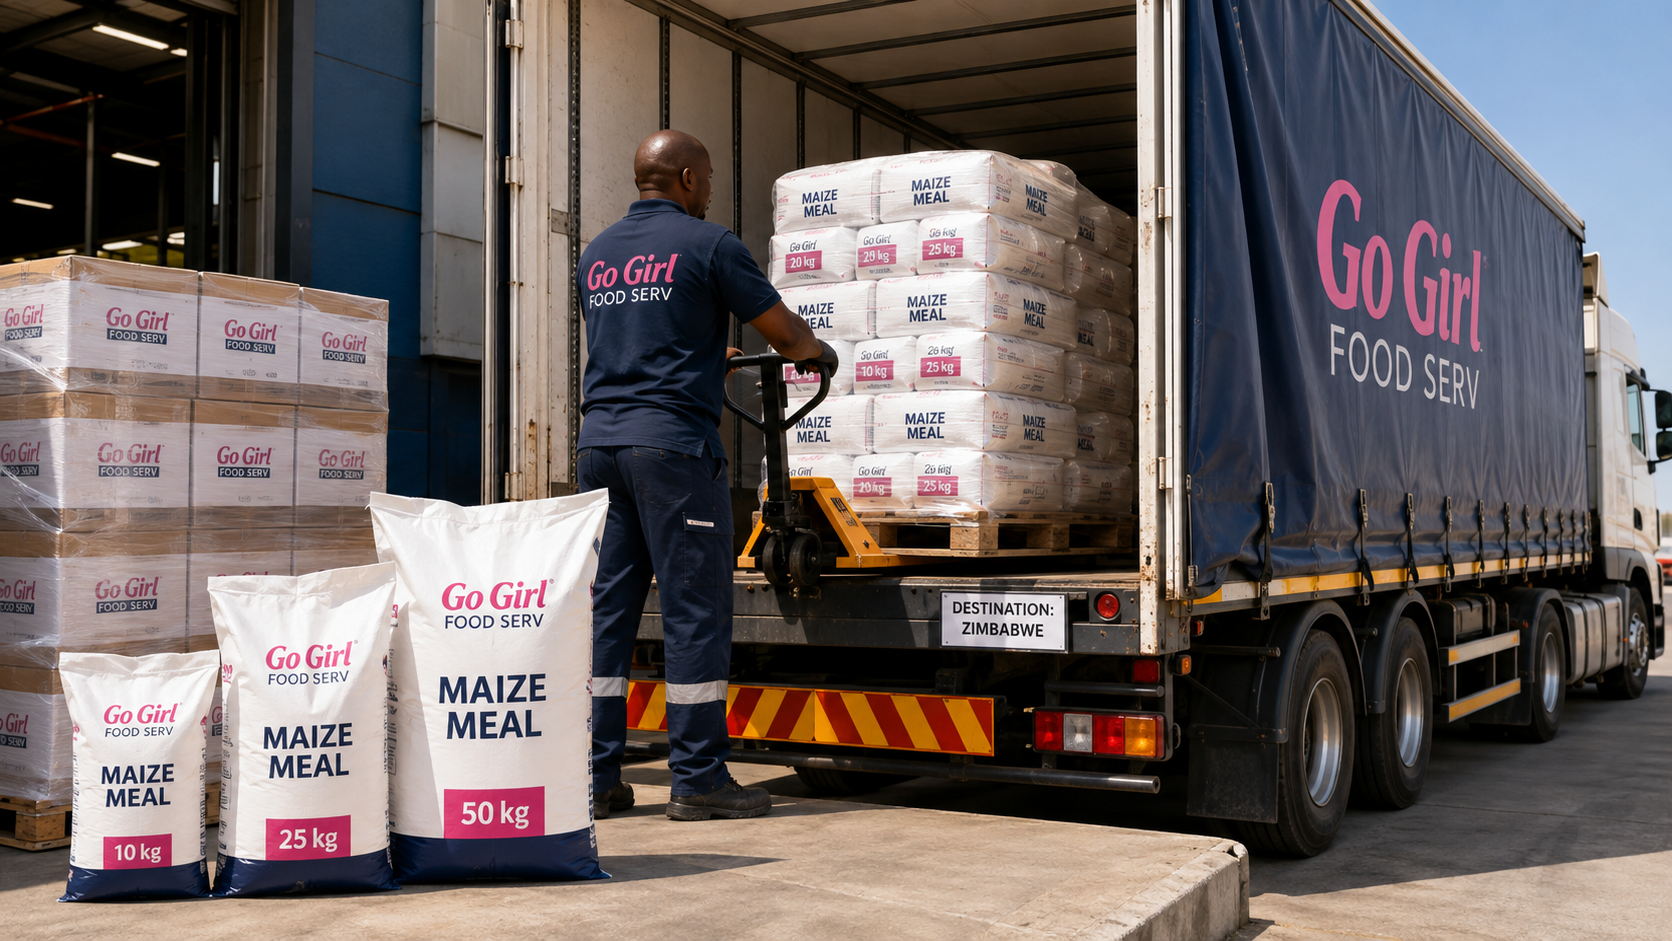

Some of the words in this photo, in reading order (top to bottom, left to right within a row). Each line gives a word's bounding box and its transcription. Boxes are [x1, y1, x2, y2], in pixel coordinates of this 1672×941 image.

[912, 176, 951, 192] MAIZE
[802, 189, 838, 204] MAIZE
[913, 190, 950, 206] MEAL
[804, 203, 837, 218] MEAL
[1026, 198, 1046, 217] MEAL
[929, 243, 942, 256] 25
[943, 242, 956, 257] kg
[790, 257, 802, 268] 20
[1316, 179, 1394, 320] Go
[1403, 220, 1481, 352] Girl
[588, 260, 618, 291] Go
[623, 254, 678, 286] Girl
[590, 290, 626, 309] FOOD
[631, 287, 672, 302] SERV
[907, 294, 947, 308] MAIZE
[4, 308, 20, 327] Go
[798, 302, 834, 316] MAIZE
[909, 308, 946, 322] MEAL
[106, 307, 132, 328] Go
[136, 310, 169, 331] Girl
[1024, 312, 1045, 329] MEAL
[109, 330, 138, 340] FOOD
[141, 333, 166, 344] SERV
[224, 319, 246, 338] Go
[249, 322, 278, 341] Girl
[226, 341, 250, 350] FOOD
[322, 332, 340, 349] Go
[342, 334, 368, 352] Girl
[324, 350, 344, 361] FOOD
[861, 365, 872, 377] 10
[874, 365, 887, 379] kg
[926, 361, 939, 373] 25
[941, 360, 954, 375] kg
[1330, 322, 1412, 392] FOOD
[1424, 353, 1479, 410] SERV
[795, 416, 832, 430] MAIZE
[905, 412, 946, 426] MAIZE
[797, 430, 831, 444] MEAL
[906, 426, 944, 440] MEAL
[1024, 428, 1044, 442] MEAL
[0, 443, 16, 463] Go
[18, 442, 40, 462] Girl
[98, 442, 124, 463] Go
[127, 444, 161, 464] Girl
[217, 446, 239, 464] Go
[242, 446, 272, 465] Girl
[319, 449, 338, 467] Go
[340, 450, 365, 468] Girl
[101, 466, 130, 476] FOOD
[132, 467, 158, 477] SERV
[220, 468, 244, 477] FOOD
[246, 468, 269, 478] SERV
[320, 470, 342, 478] FOOD
[923, 480, 937, 492] 25
[938, 480, 952, 494] kg
[14, 580, 36, 600] Girl
[95, 580, 121, 600] Go
[125, 576, 160, 598] Girl
[442, 582, 484, 610] Go
[490, 579, 546, 610] Girl
[99, 602, 126, 612] FOOD
[130, 600, 156, 610] SERV
[953, 601, 1054, 616] DESTINATION:
[445, 614, 494, 630] FOOD
[500, 613, 544, 628] SERV
[962, 622, 1044, 638] ZIMBABWE
[266, 645, 300, 670] Go
[305, 641, 352, 669] Girl
[268, 672, 309, 686] FOOD
[313, 671, 349, 684] SERV
[439, 673, 547, 704] MAIZE
[104, 705, 132, 724] Go
[136, 703, 178, 724] Girl
[6, 713, 28, 734] Girl
[105, 727, 140, 738] FOOD
[144, 726, 174, 737] SERV
[446, 709, 542, 740] MEAL
[263, 722, 353, 750] MAIZE
[101, 763, 174, 784] MAIZE
[269, 752, 350, 779] MEAL
[106, 787, 170, 808] MEAL
[460, 801, 494, 826] 50
[501, 800, 530, 829] kg
[278, 829, 307, 850] 25
[312, 828, 338, 852] kg
[114, 844, 136, 861] 10
[140, 843, 162, 862] kg
